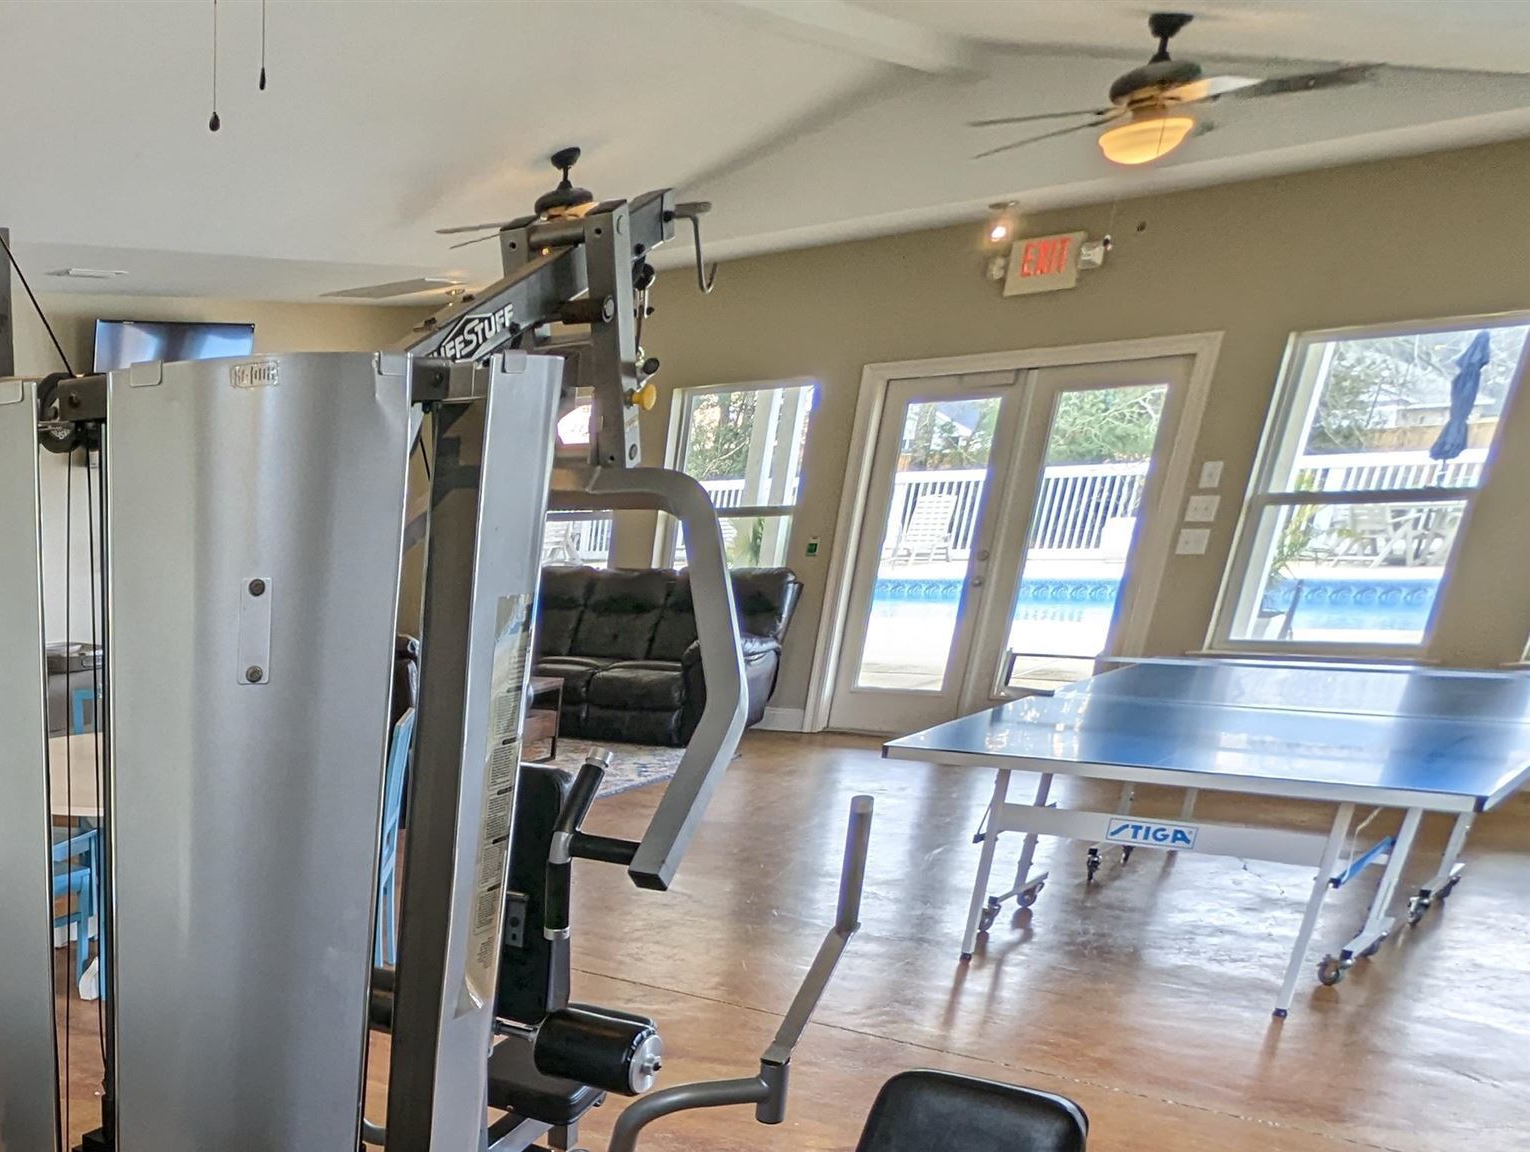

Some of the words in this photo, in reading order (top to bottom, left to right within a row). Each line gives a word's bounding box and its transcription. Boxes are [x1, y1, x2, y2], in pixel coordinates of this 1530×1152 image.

[1019, 236, 1073, 277] EXIT
[430, 303, 514, 359] FFSTUFF
[1110, 824, 1191, 845] STIGA
